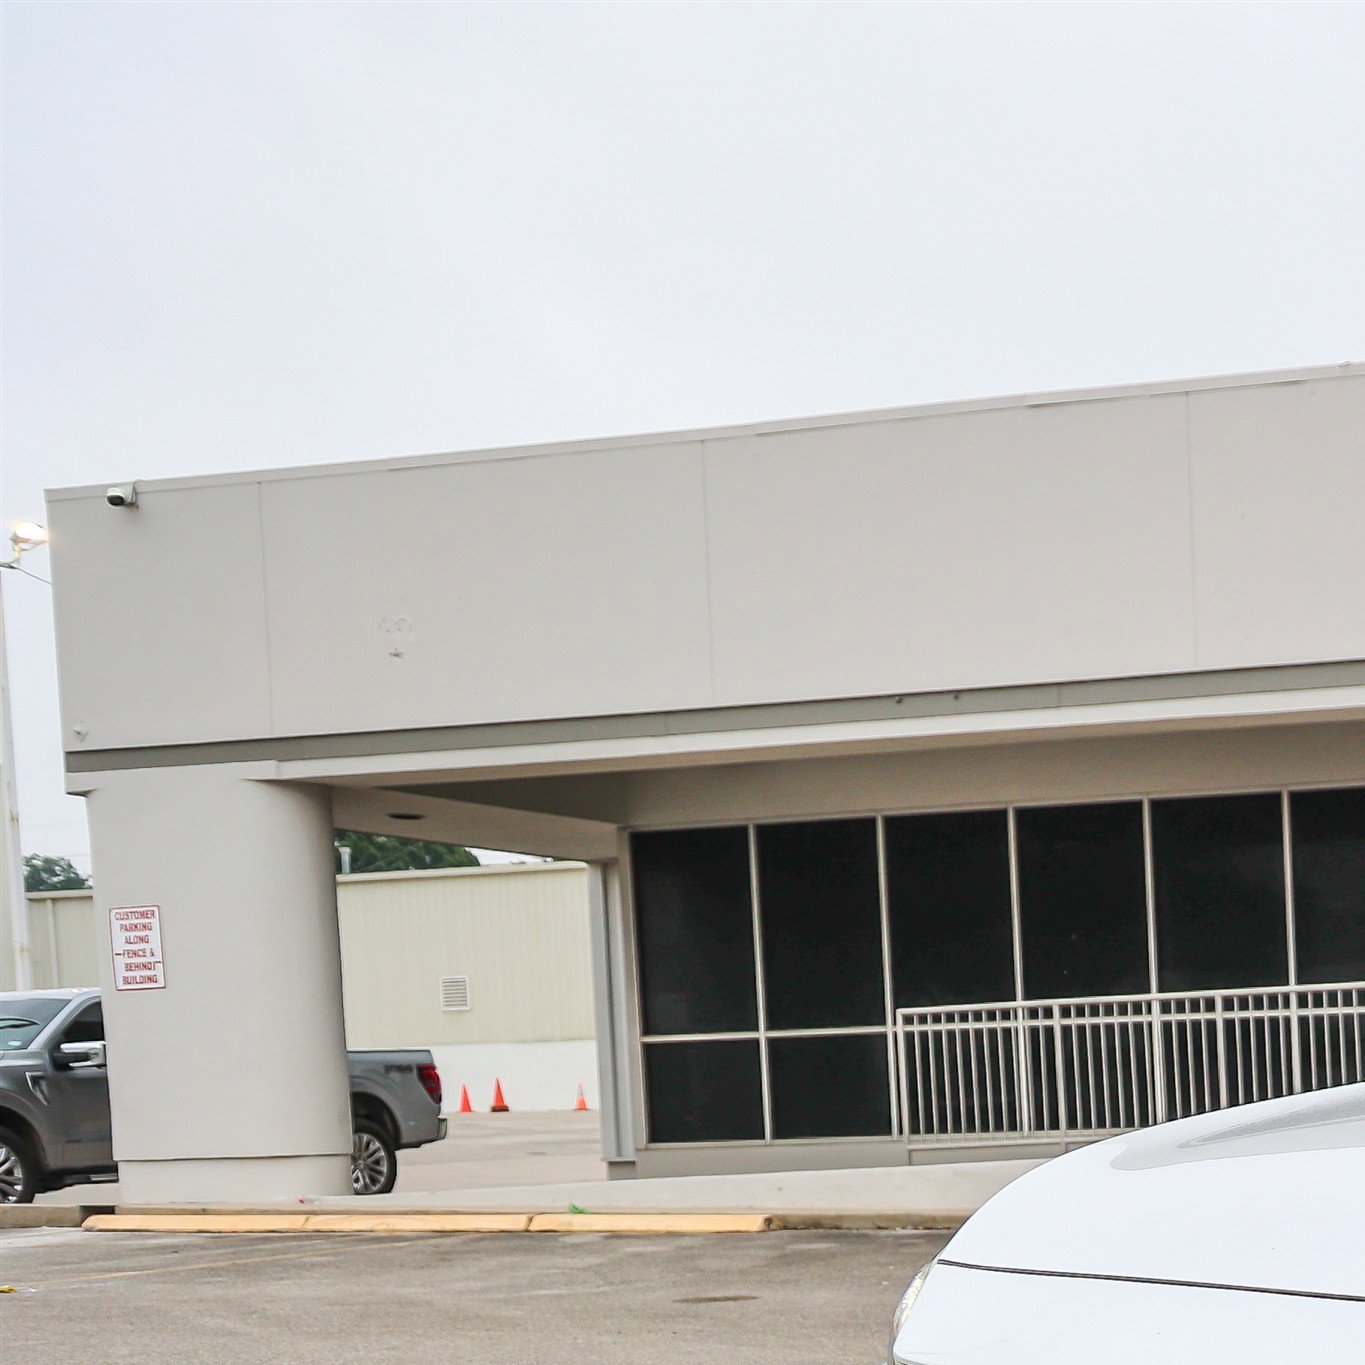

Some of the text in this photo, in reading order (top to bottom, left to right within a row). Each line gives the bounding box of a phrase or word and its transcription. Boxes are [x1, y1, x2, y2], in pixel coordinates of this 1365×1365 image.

[115, 910, 155, 920] CUSTOMER
[120, 922, 153, 932] PARKING
[124, 934, 150, 945] ALONG
[122, 948, 147, 959] FENCE
[124, 962, 153, 972] BEHIND
[122, 975, 158, 985] BUILDING
